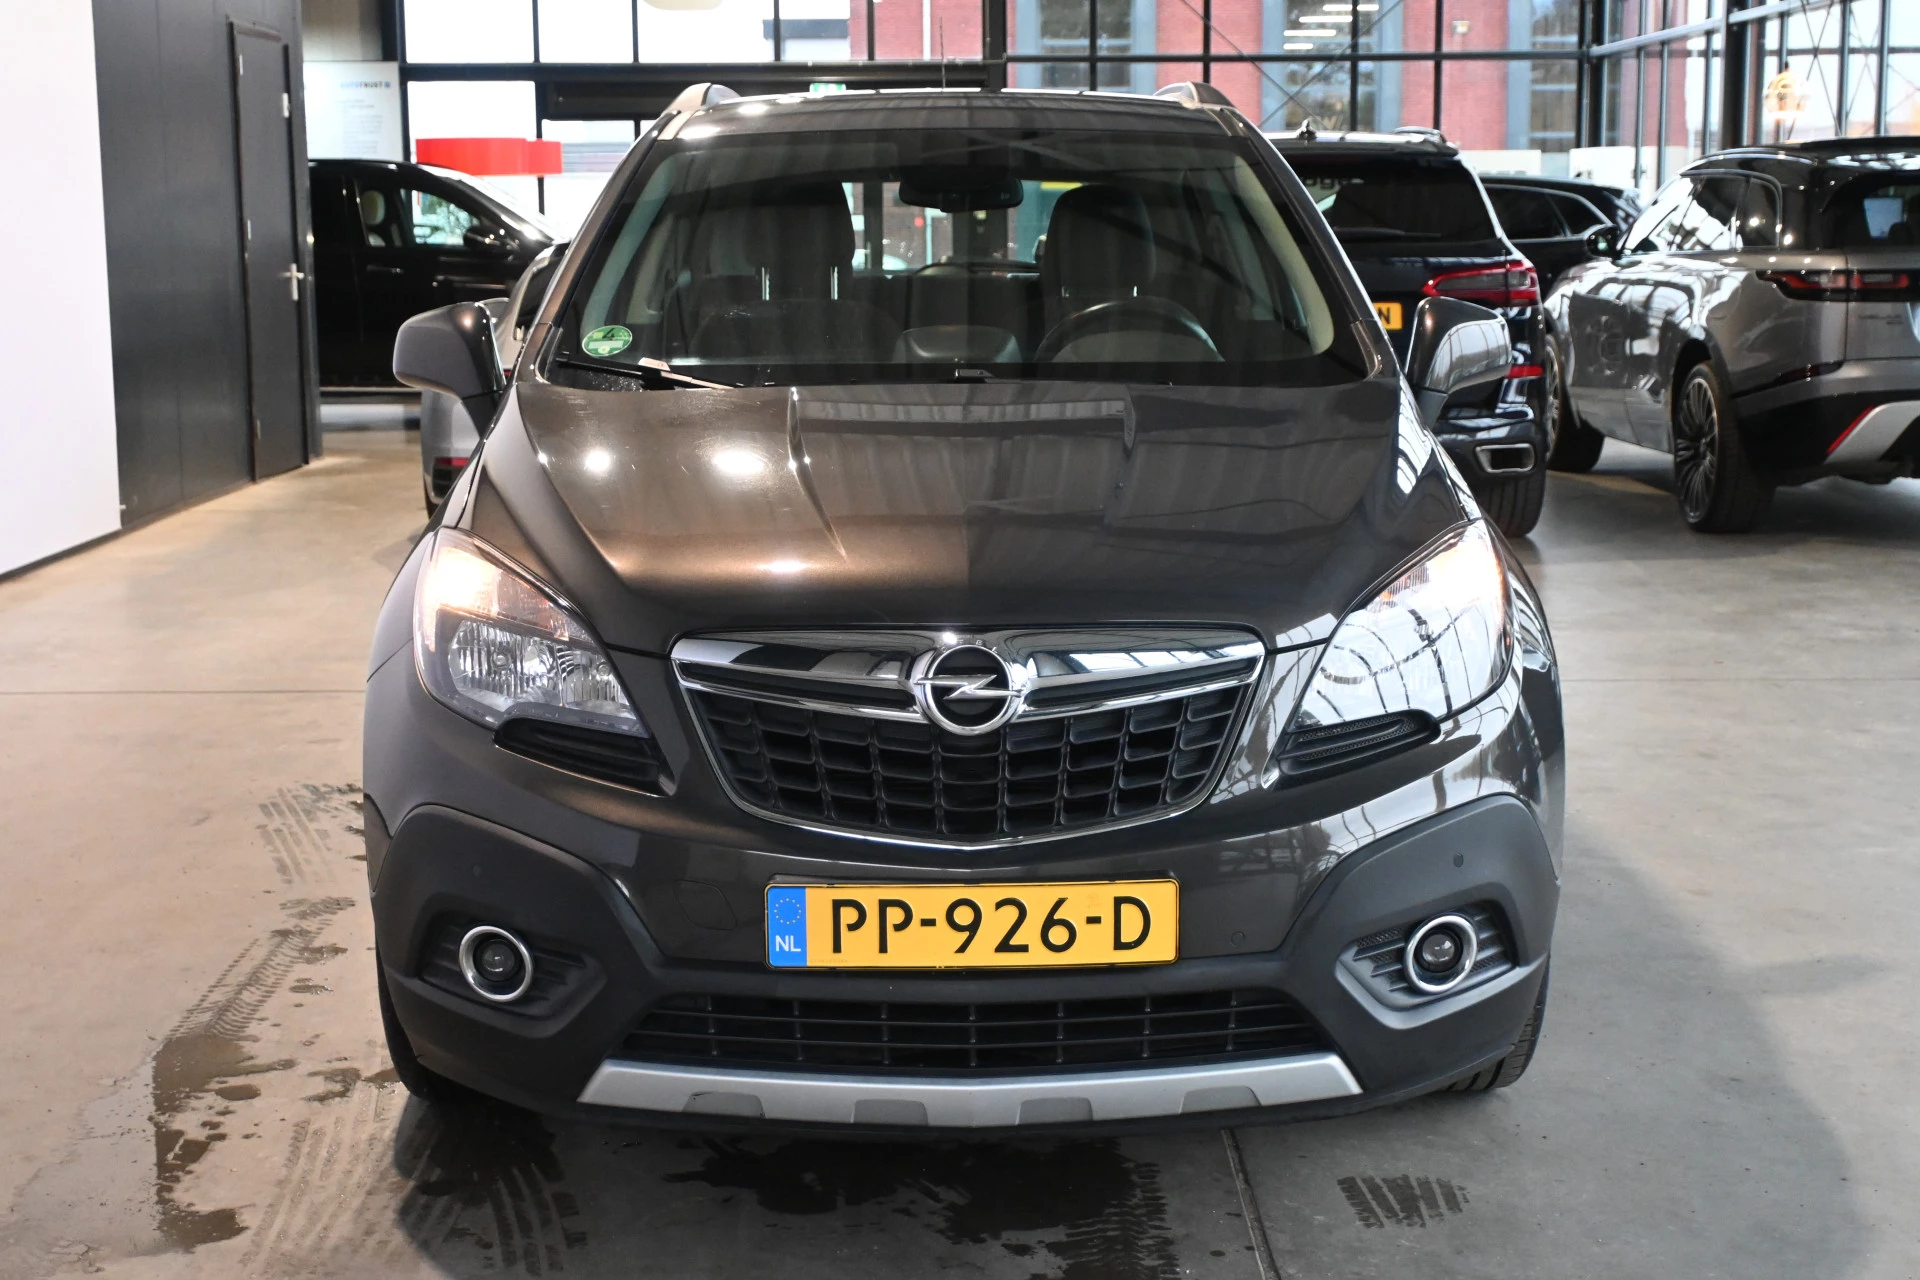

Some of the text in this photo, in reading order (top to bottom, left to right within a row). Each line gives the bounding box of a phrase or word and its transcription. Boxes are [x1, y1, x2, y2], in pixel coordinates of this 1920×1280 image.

[602, 328, 615, 340] 4
[775, 895, 1151, 955] NL PP-926-D
